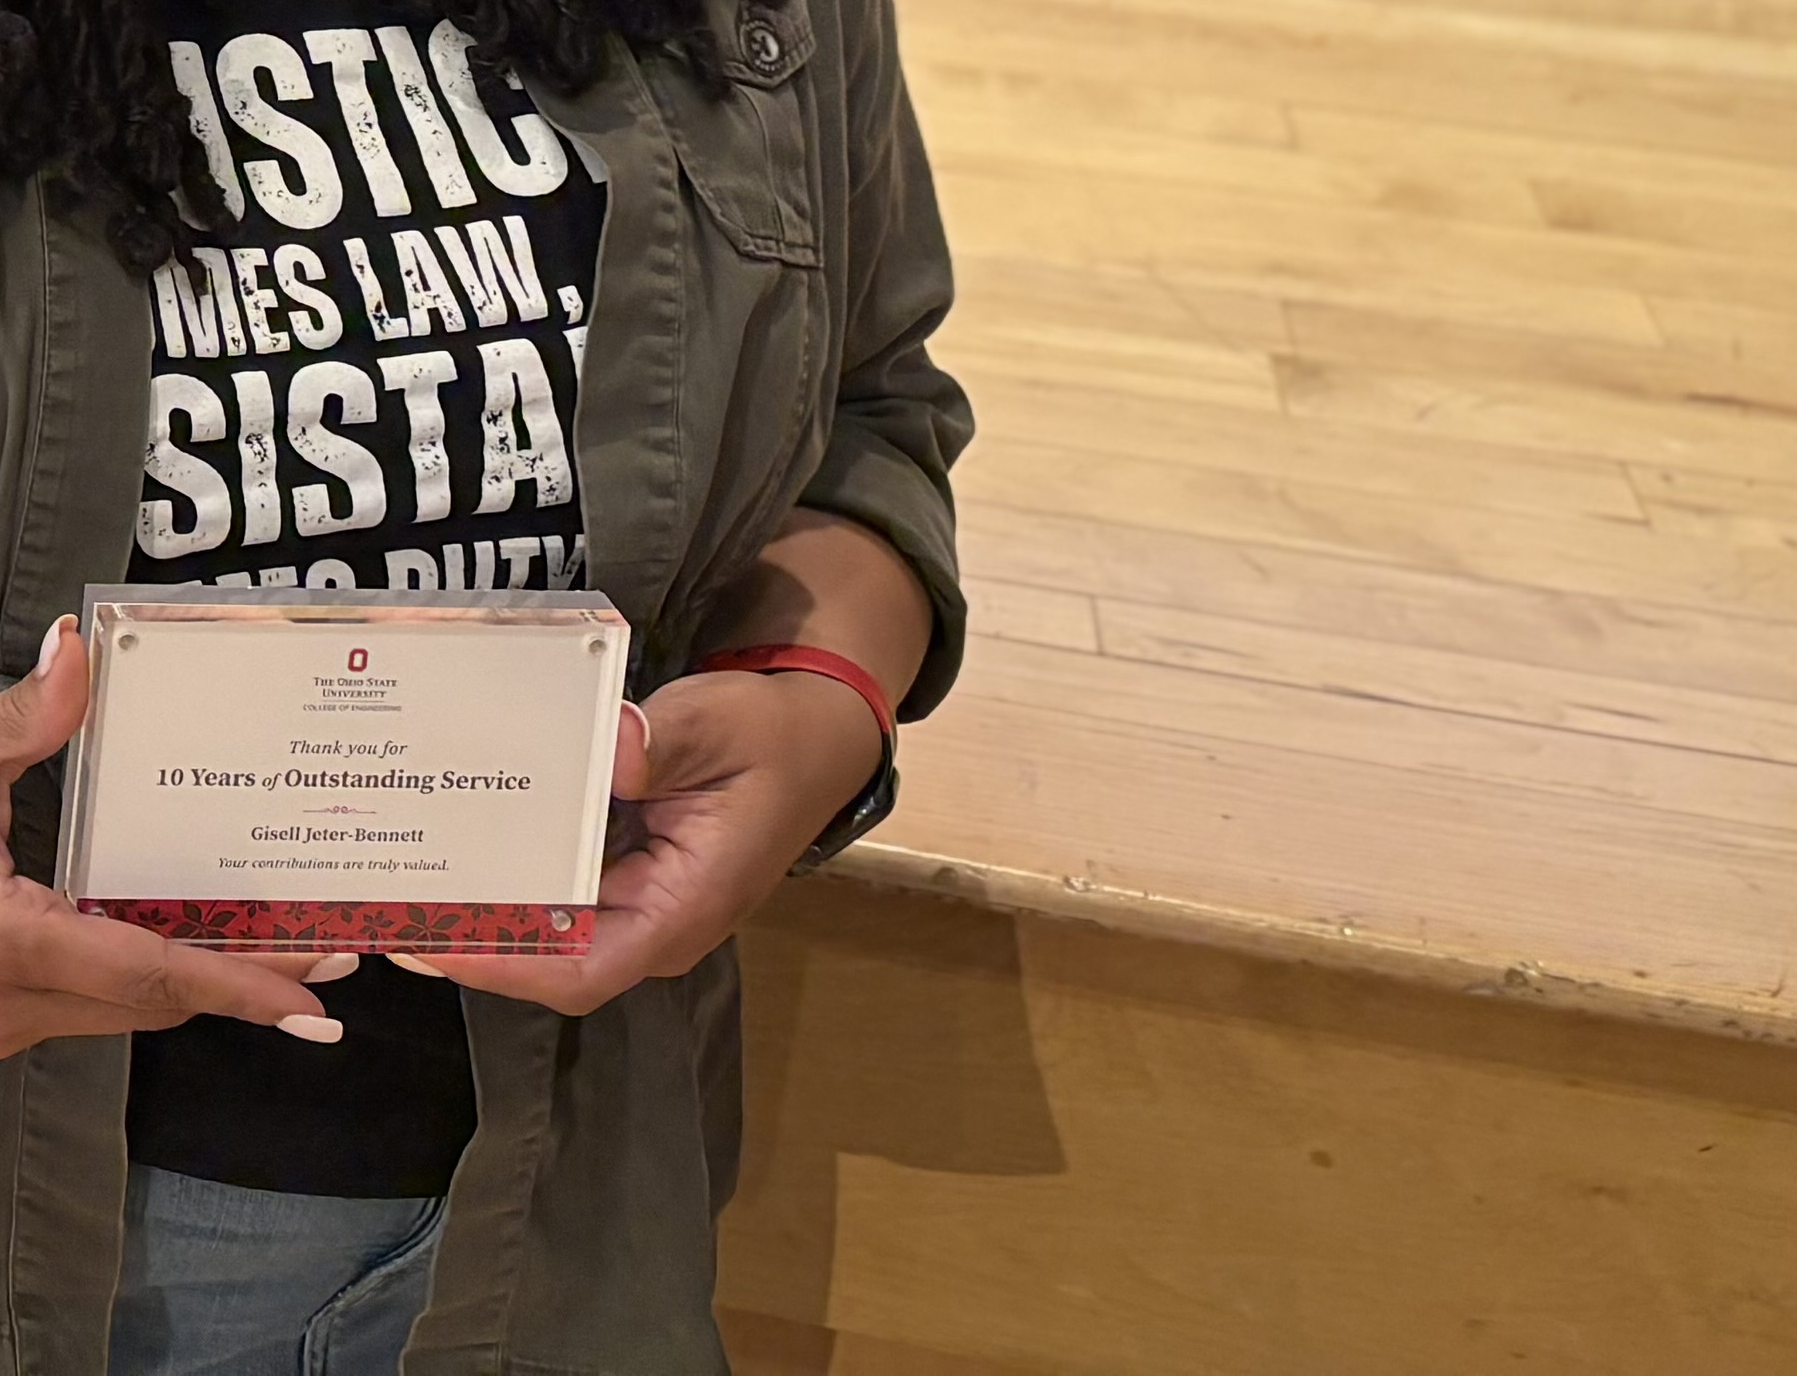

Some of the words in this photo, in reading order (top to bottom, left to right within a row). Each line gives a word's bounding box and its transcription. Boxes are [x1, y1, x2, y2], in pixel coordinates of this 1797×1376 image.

[168, 18, 608, 230] STIC
[136, 326, 588, 559] SISTA
[313, 677, 335, 687] THE
[337, 677, 364, 687] OHIO
[366, 677, 397, 688] STATE
[322, 688, 387, 699] UNIVERSITY
[290, 740, 342, 755] Thank
[343, 743, 377, 758] you
[378, 740, 408, 759] for
[156, 768, 184, 787] 10
[190, 768, 256, 787] Years
[261, 772, 282, 792] of
[284, 768, 436, 795] Outstanding
[440, 770, 531, 790] Service
[250, 825, 300, 841] Gisell
[302, 827, 424, 844] Jeter-Bennett
[218, 856, 248, 869] Your
[251, 857, 339, 870] contributions
[342, 860, 364, 870] are
[367, 858, 400, 873] truly
[403, 859, 450, 871] valued.
